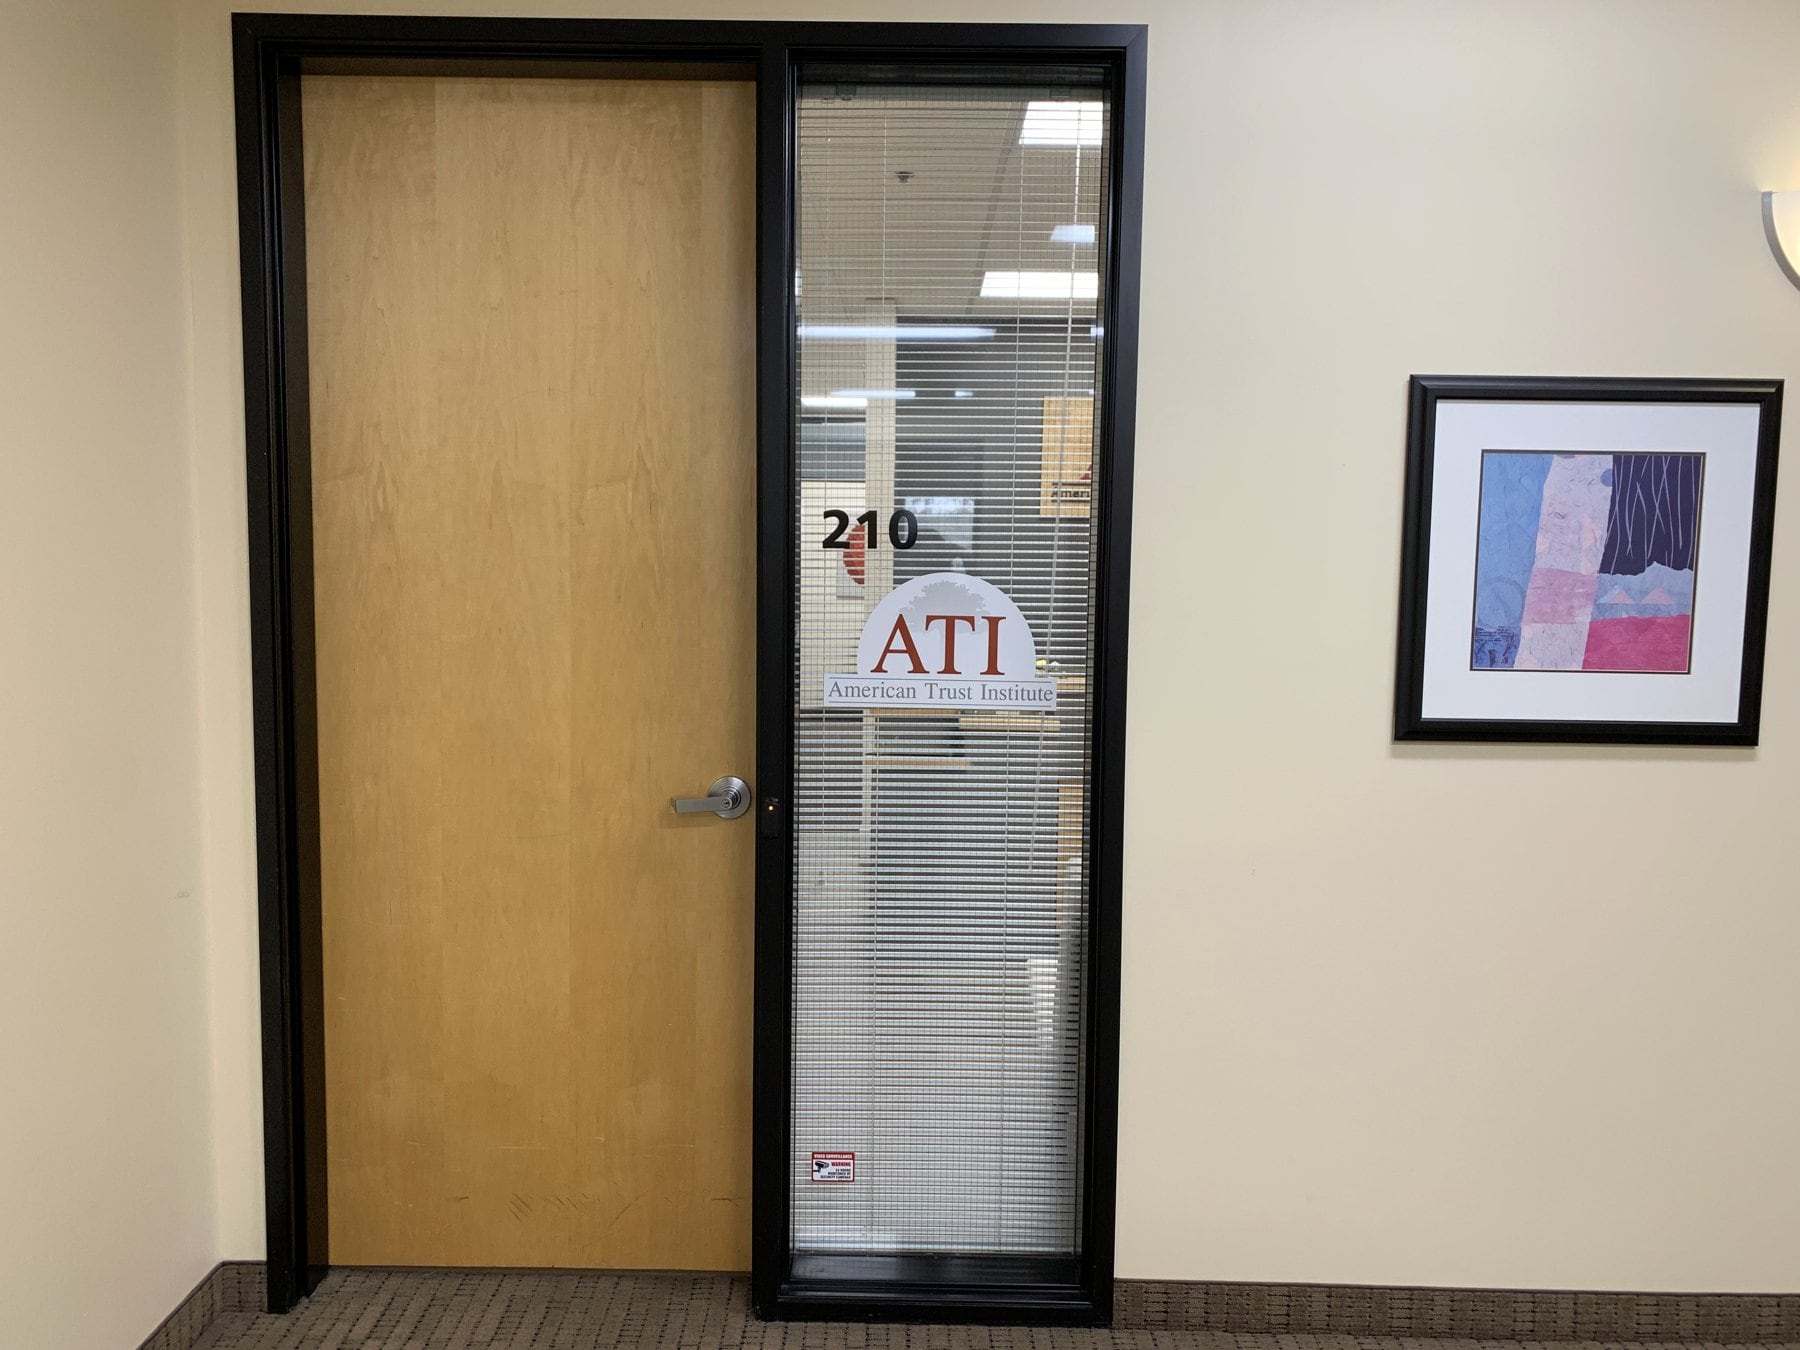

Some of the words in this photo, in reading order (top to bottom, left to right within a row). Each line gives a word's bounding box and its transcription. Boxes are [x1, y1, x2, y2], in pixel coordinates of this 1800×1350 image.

[822, 510, 918, 549] 210
[870, 613, 1007, 675] ATI
[828, 681, 917, 699] American
[924, 682, 973, 700] Trust
[980, 683, 1054, 702] Institute
